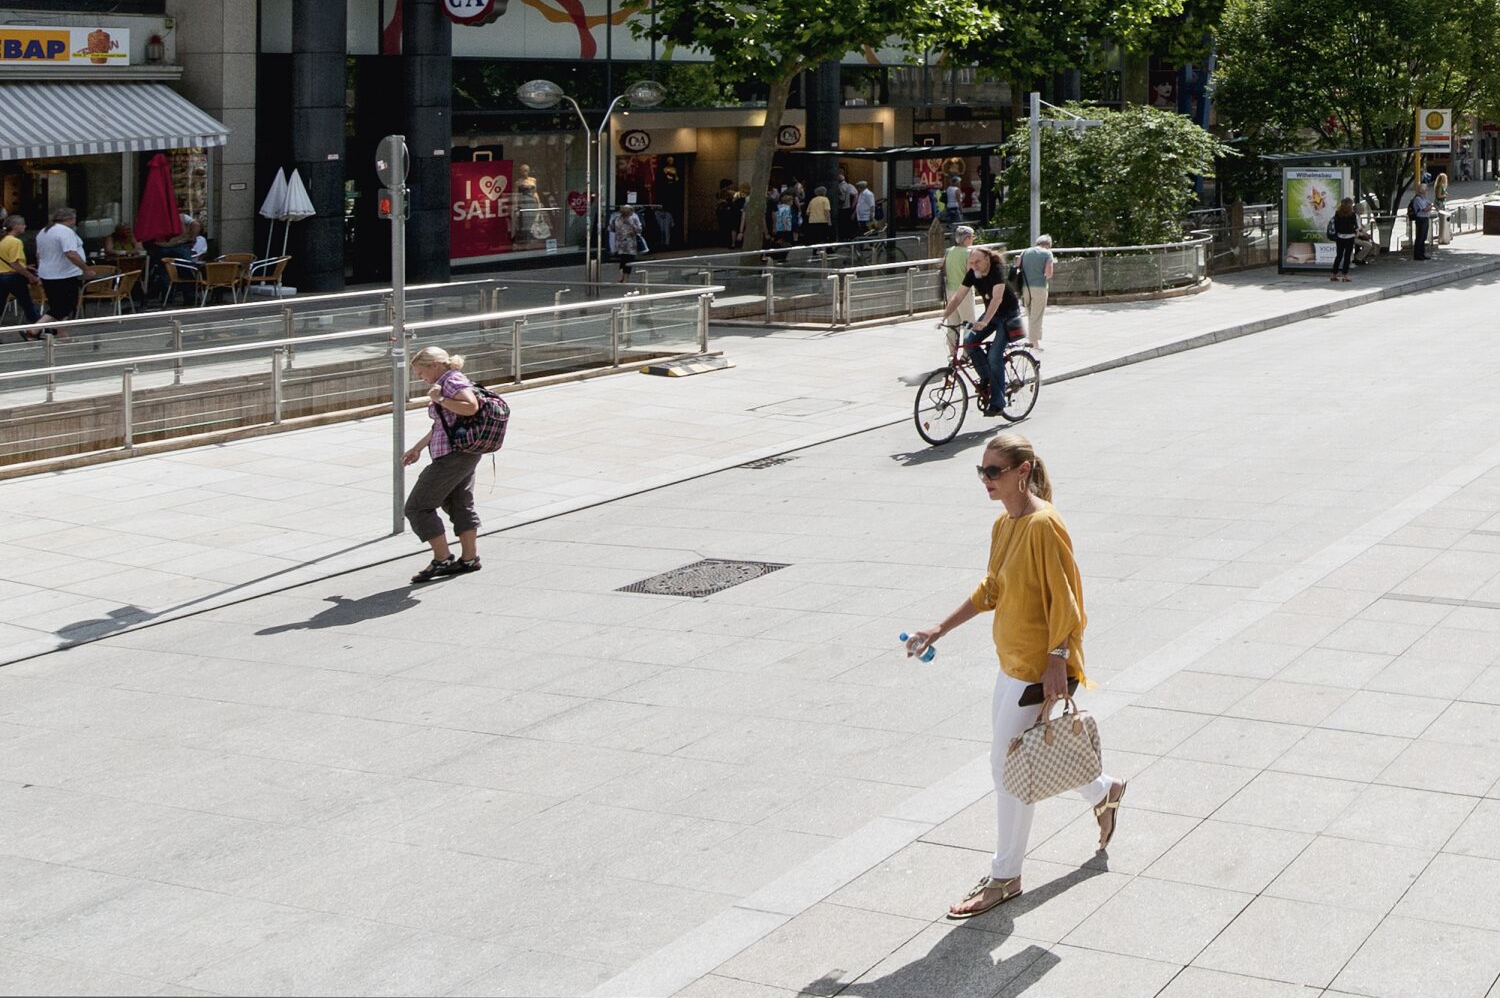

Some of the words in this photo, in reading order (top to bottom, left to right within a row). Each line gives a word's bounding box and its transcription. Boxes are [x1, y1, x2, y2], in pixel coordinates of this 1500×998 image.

[0, 39, 66, 59] BAP
[628, 134, 646, 147] C&A
[466, 180, 472, 200] I
[453, 197, 511, 222] SALE
